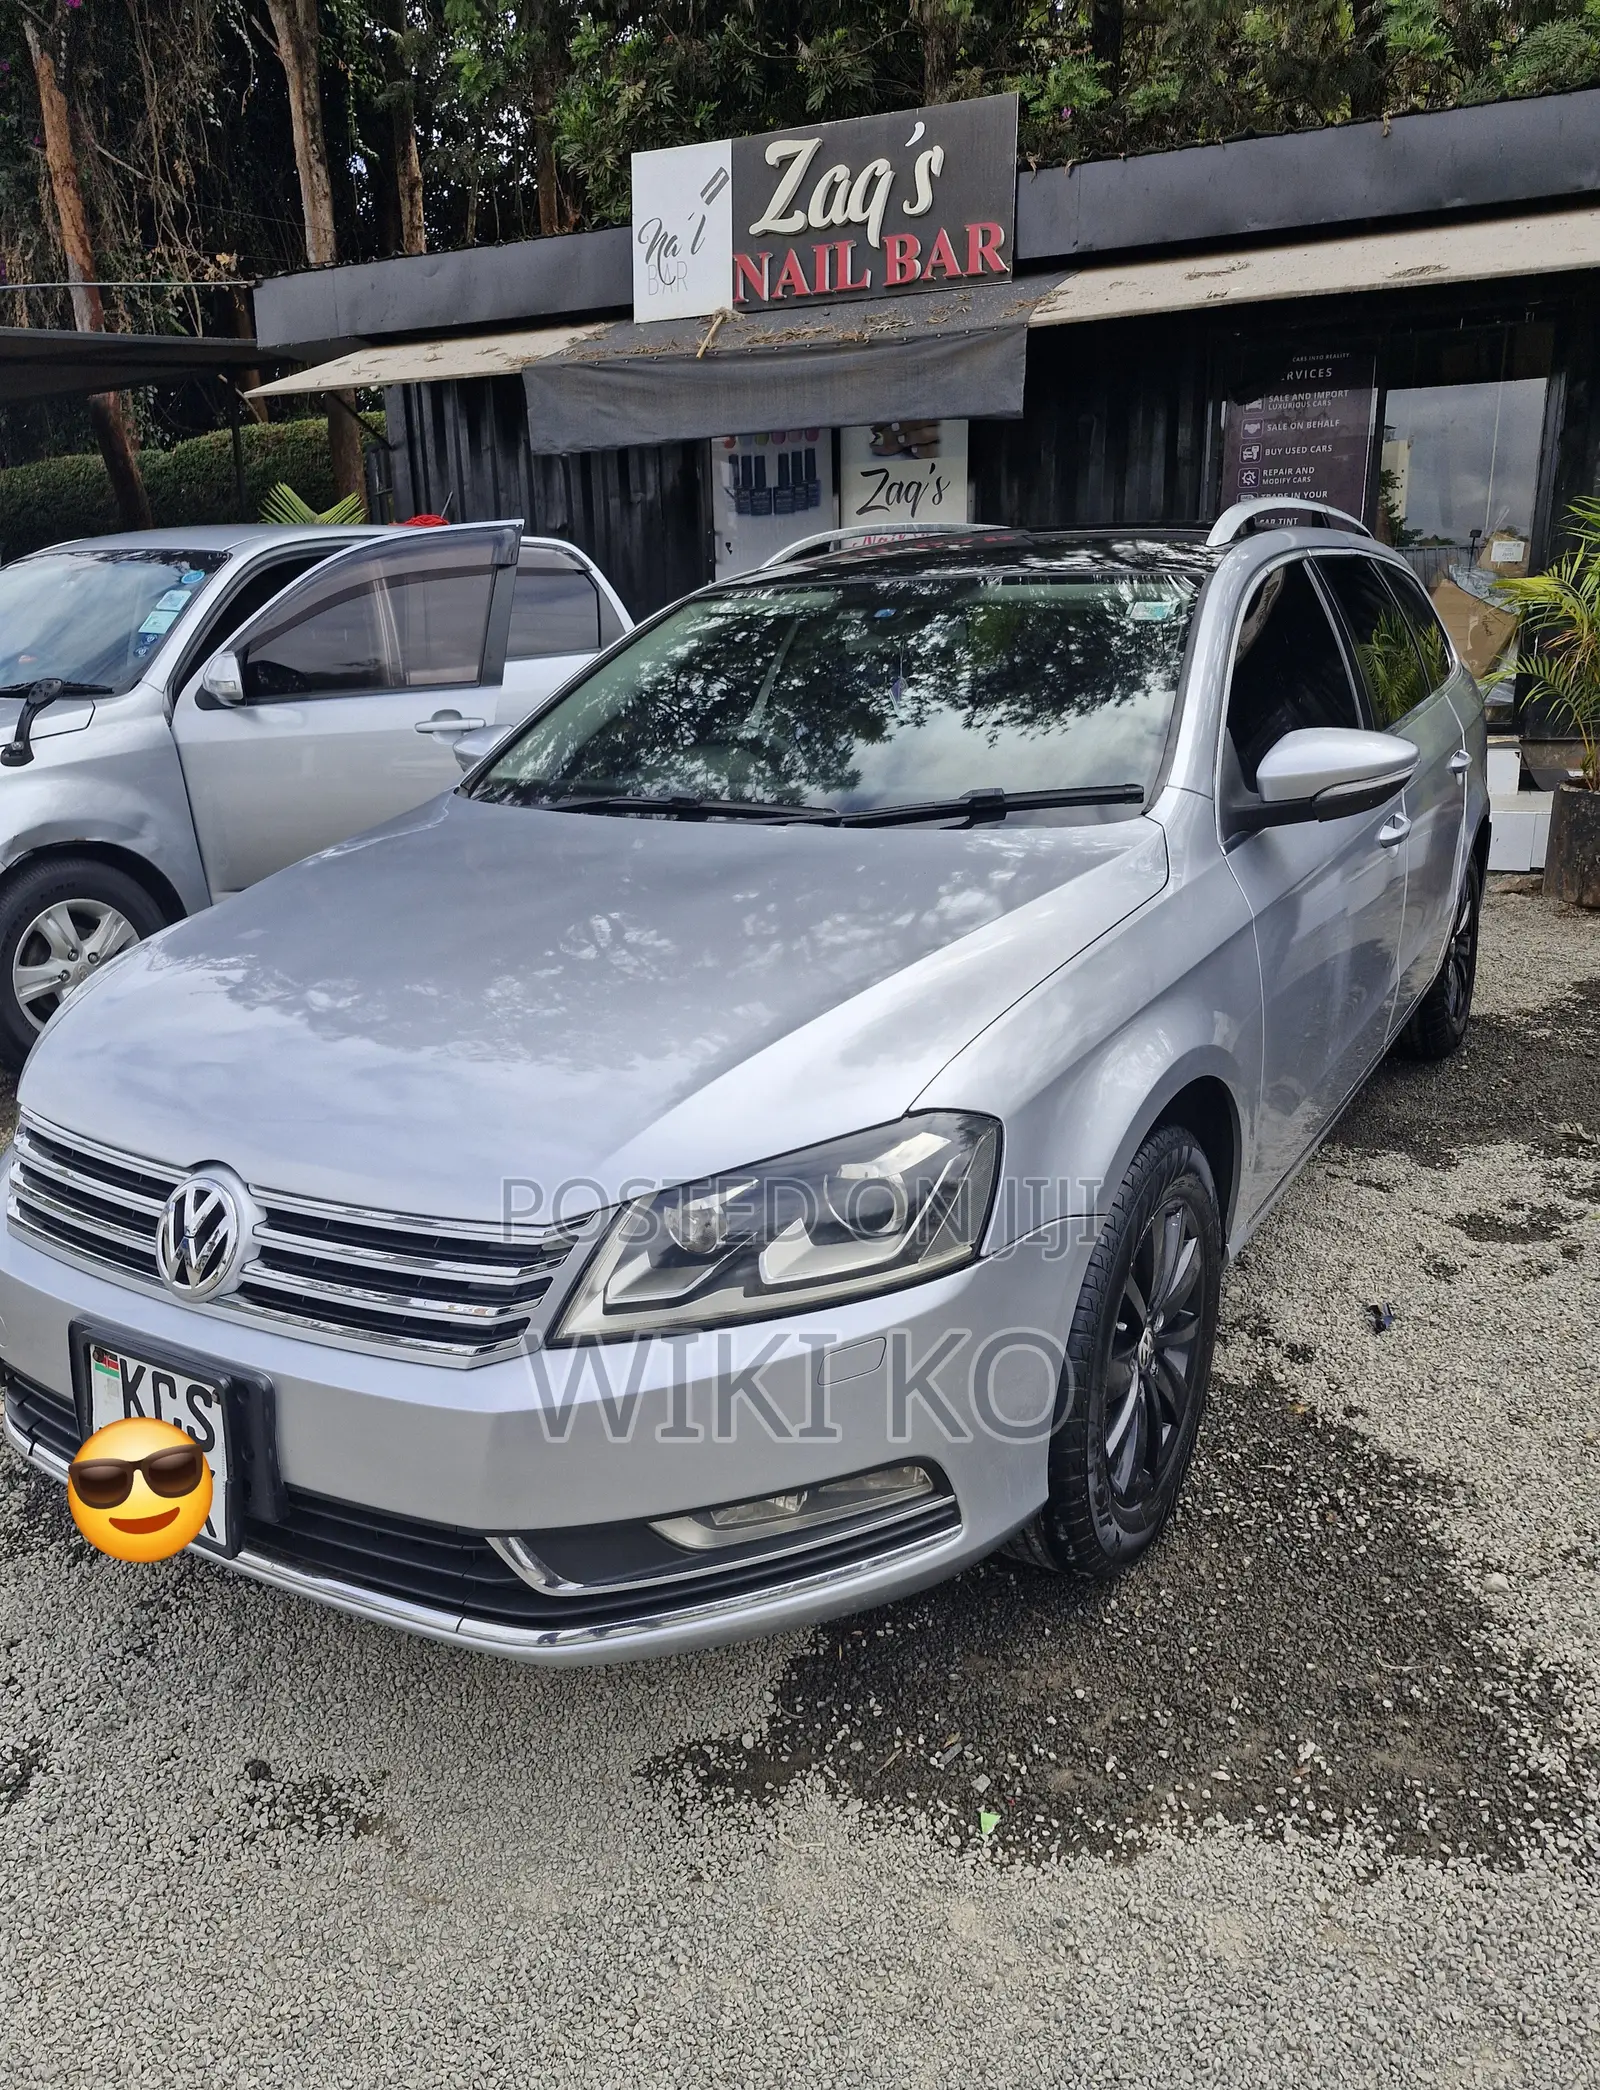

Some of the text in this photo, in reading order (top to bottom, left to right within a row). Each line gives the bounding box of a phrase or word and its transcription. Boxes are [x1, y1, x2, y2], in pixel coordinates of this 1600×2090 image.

[748, 121, 944, 248] Zaq's
[732, 221, 1010, 302] NAIL BAR
[648, 261, 688, 295] BAR
[1281, 368, 1333, 380] RVICES
[1268, 390, 1350, 403] SALE AND IMPORT
[1268, 402, 1311, 410] LUXURIOUS
[1267, 424, 1288, 432] SALE
[1306, 420, 1340, 429] BEHALF
[1265, 445, 1333, 456] BUY USED CARS
[1262, 467, 1315, 476] REPAIR AND
[856, 463, 950, 518] Zaq's
[1303, 491, 1328, 499] YOUR
[1278, 518, 1299, 526] TINT
[120, 1358, 216, 1453] KCS
